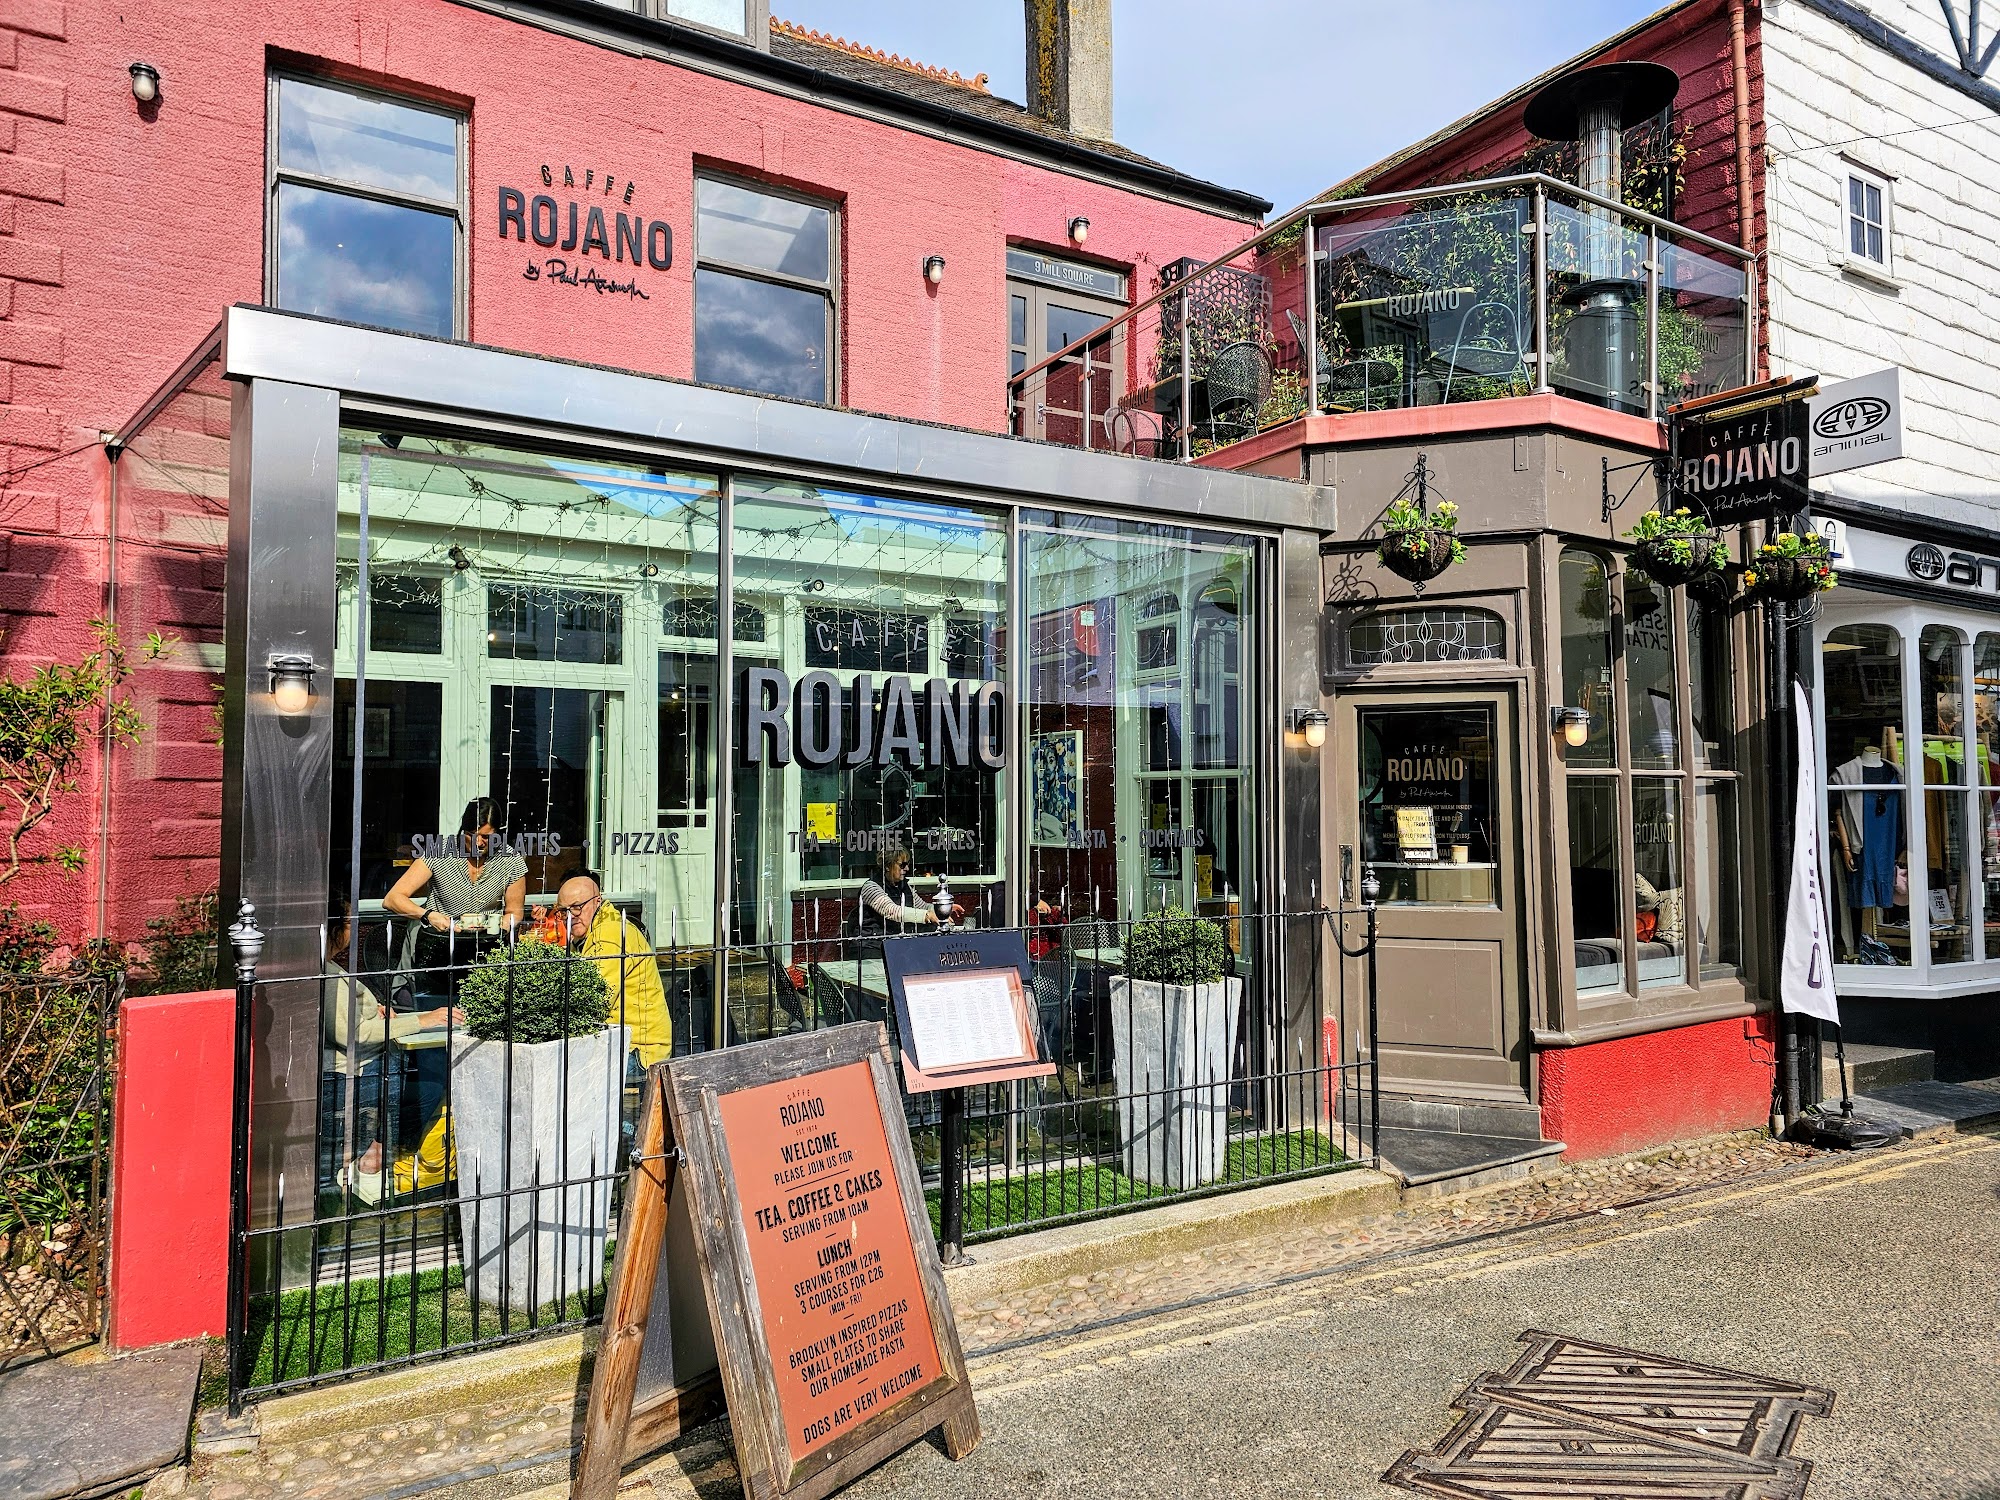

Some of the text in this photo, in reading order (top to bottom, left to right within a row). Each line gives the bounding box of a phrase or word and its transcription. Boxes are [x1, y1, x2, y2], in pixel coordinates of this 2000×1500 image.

[498, 186, 673, 272] ROJANO
[522, 259, 541, 281] by
[545, 258, 579, 286] Paul
[1034, 260, 1094, 286] 9 MILL SQUARE
[1386, 287, 1461, 319] ROJANO
[1683, 436, 1801, 495] ROJANO
[1713, 494, 1735, 512] Paul
[740, 667, 1007, 773] ROJANO
[1387, 757, 1465, 782] ROJANO
[410, 832, 680, 859] SMALL PLATES PIZZAS
[787, 829, 976, 853] TEA COFFEE CAKES
[1067, 828, 1205, 849] PASTA COCKTAILS
[1634, 822, 1674, 844] ROJANO
[939, 950, 980, 967] ROJANO
[780, 1097, 825, 1127] ROJANO
[781, 1132, 840, 1164] WELCOME
[774, 1150, 854, 1186] PLEASE JOIN US FOR
[788, 1186, 833, 1221] COFFEE
[834, 1183, 845, 1202] &
[845, 1169, 883, 1199] CAKES
[782, 1199, 869, 1243] SERVING FROM 10AM
[816, 1239, 853, 1269] LUNCH
[794, 1249, 881, 1299] SERVING FROM 12PM
[800, 1265, 884, 1315] 3 COURSES FOR £26
[789, 1299, 908, 1370] BROOKLYN INSPIRED PIZZAS
[801, 1317, 906, 1383] SMALL PLATES TO SHARE
[810, 1336, 905, 1398] OUR HOMEMADE PASTA
[803, 1363, 923, 1445] DOGS ARE VERY WELCOME
